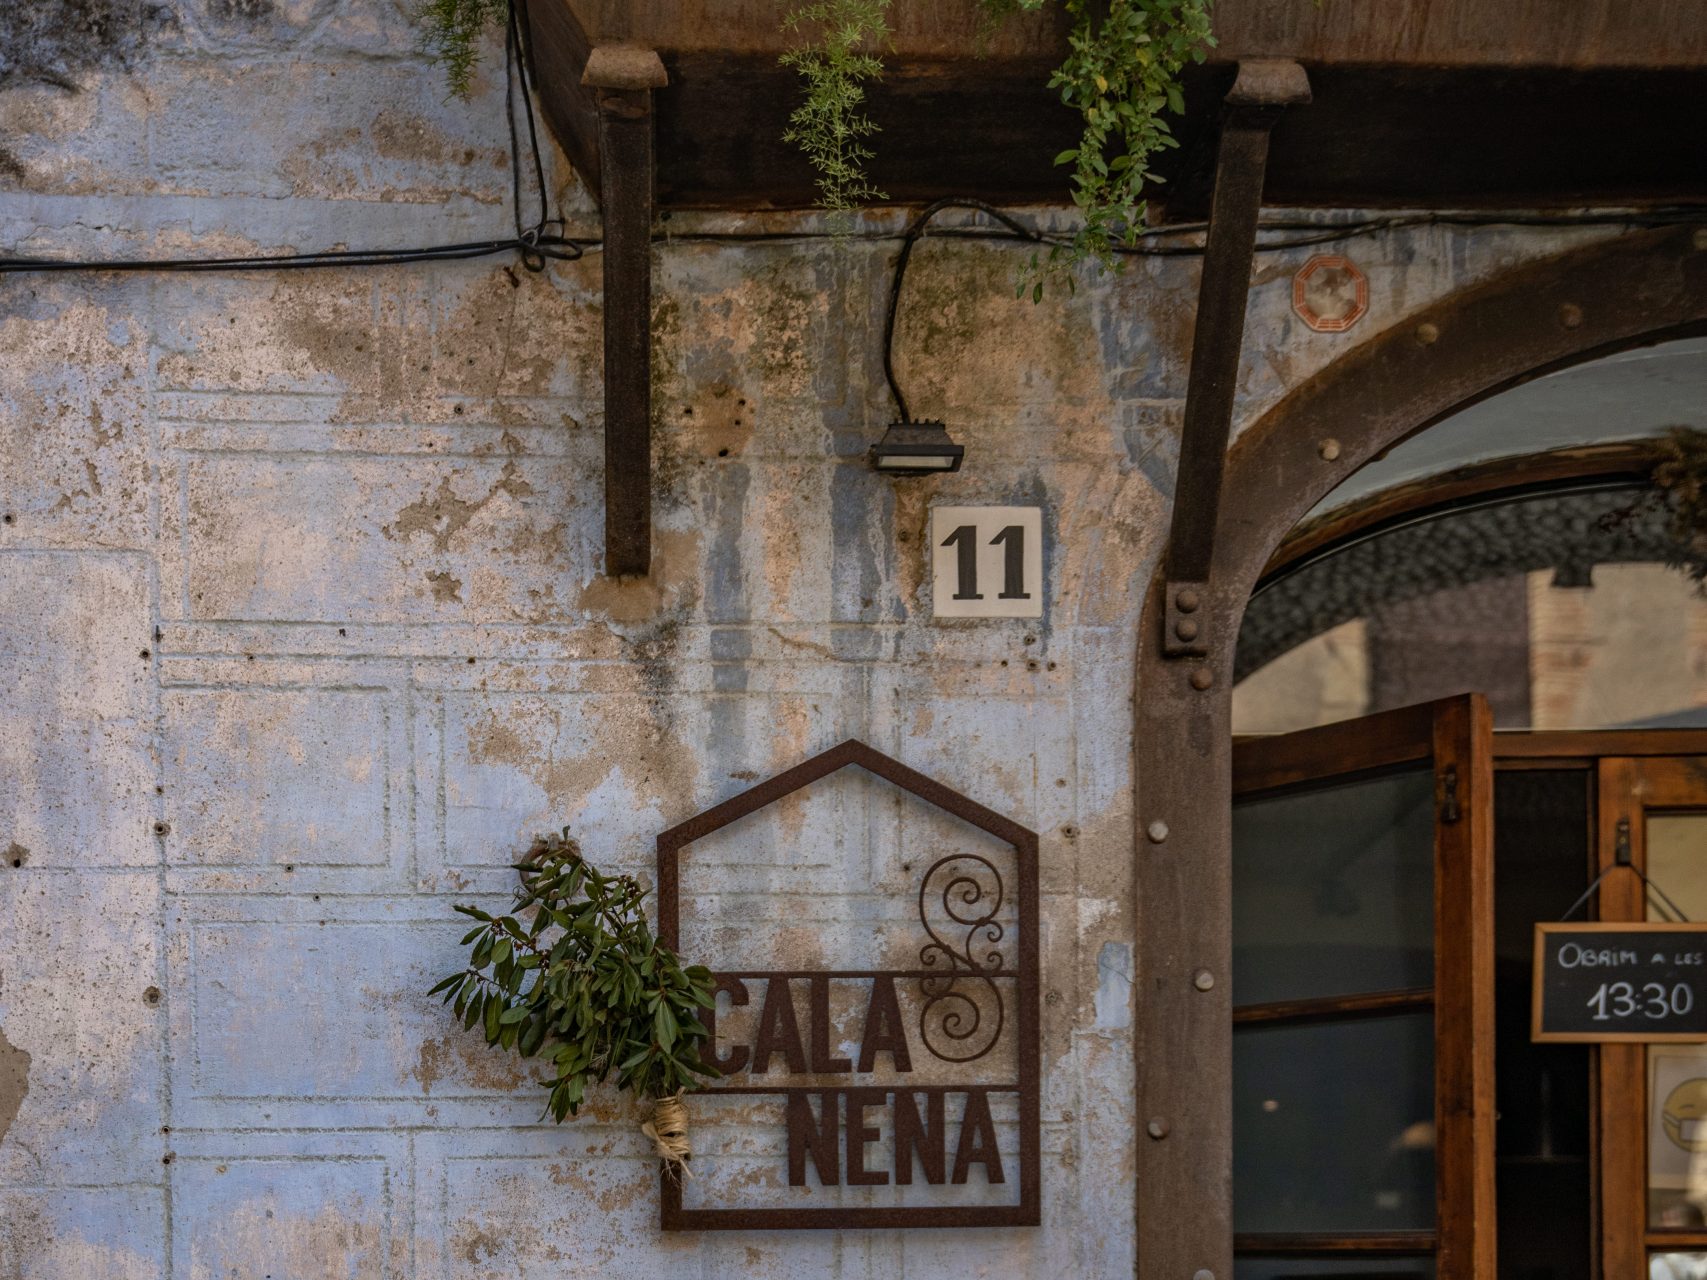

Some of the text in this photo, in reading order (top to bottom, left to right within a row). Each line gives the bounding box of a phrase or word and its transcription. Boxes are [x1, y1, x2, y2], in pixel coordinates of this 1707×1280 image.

[940, 525, 1031, 600] 11
[697, 973, 913, 1075] CALA
[1586, 981, 1694, 1020] 13:30
[788, 1088, 1006, 1187] NENA
